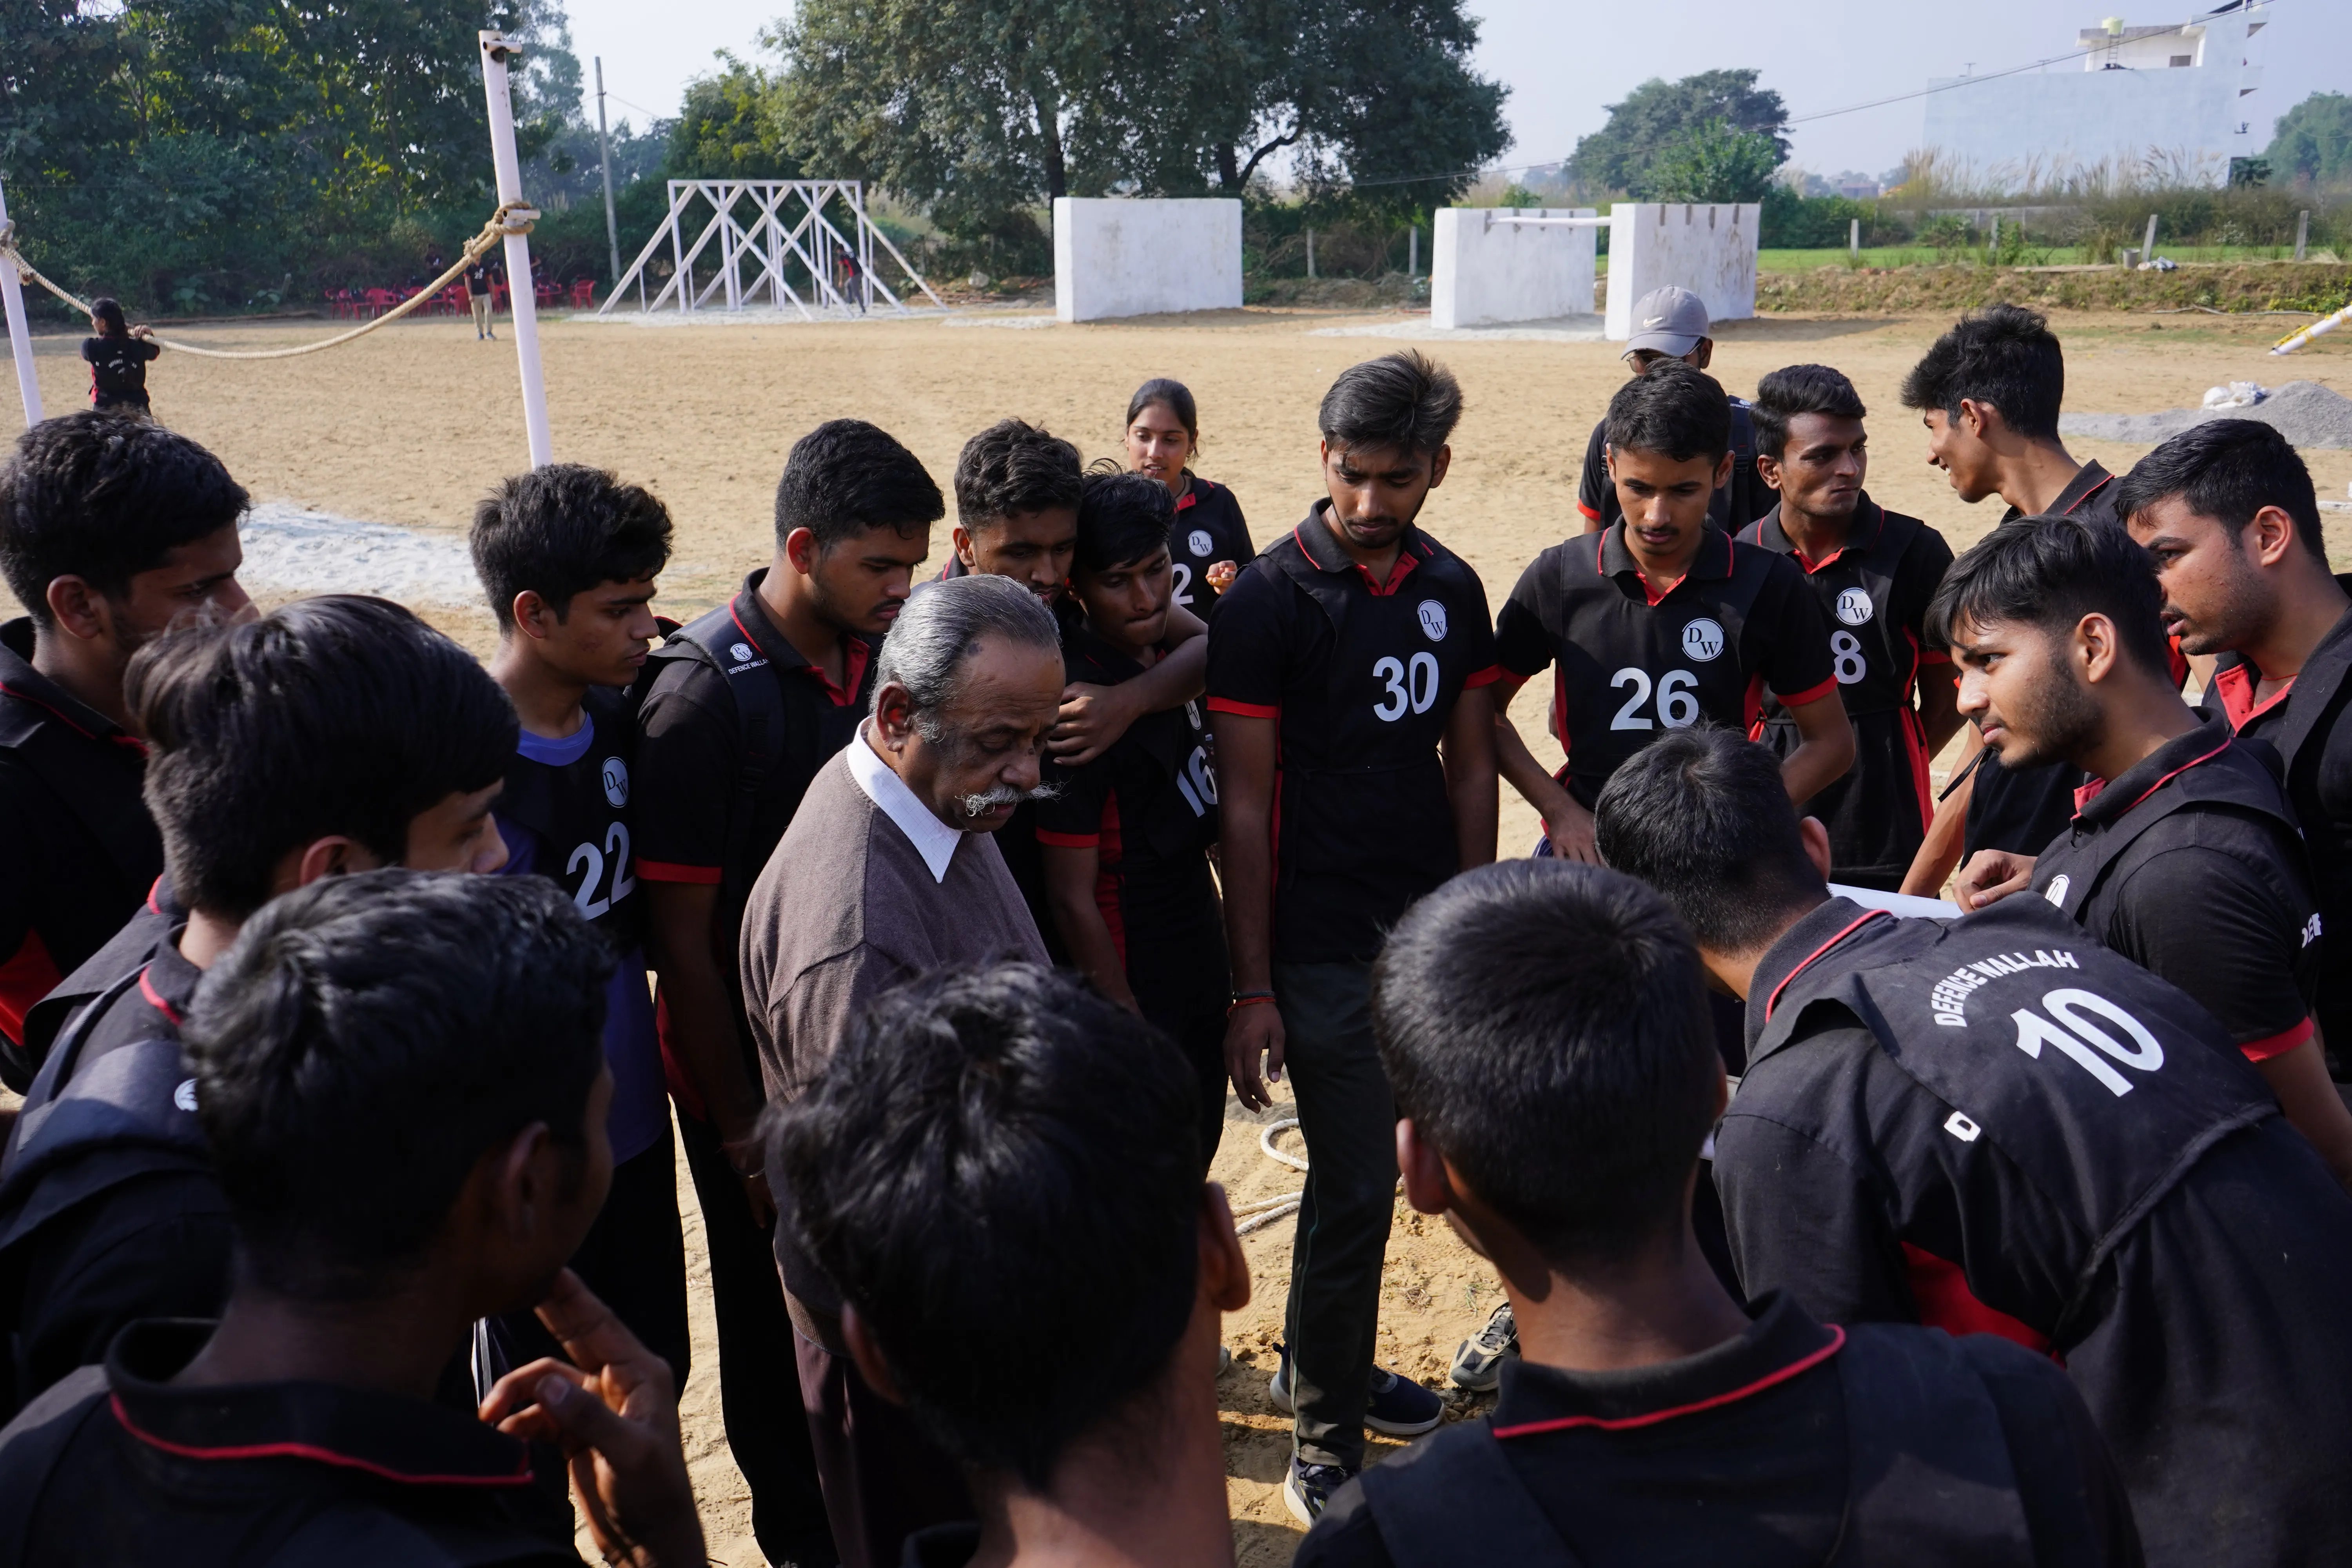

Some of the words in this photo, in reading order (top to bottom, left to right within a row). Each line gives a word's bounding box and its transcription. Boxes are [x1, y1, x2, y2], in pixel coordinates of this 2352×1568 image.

[728, 663, 751, 675] DEFENCE
[1372, 652, 1439, 722] 30
[1610, 667, 1699, 731] 26
[1176, 745, 1218, 818] 16
[566, 821, 637, 921] 22
[1931, 967, 1988, 1027] DEFENCE
[1967, 949, 2079, 978] WALLAH
[2010, 988, 2164, 1098] 10
